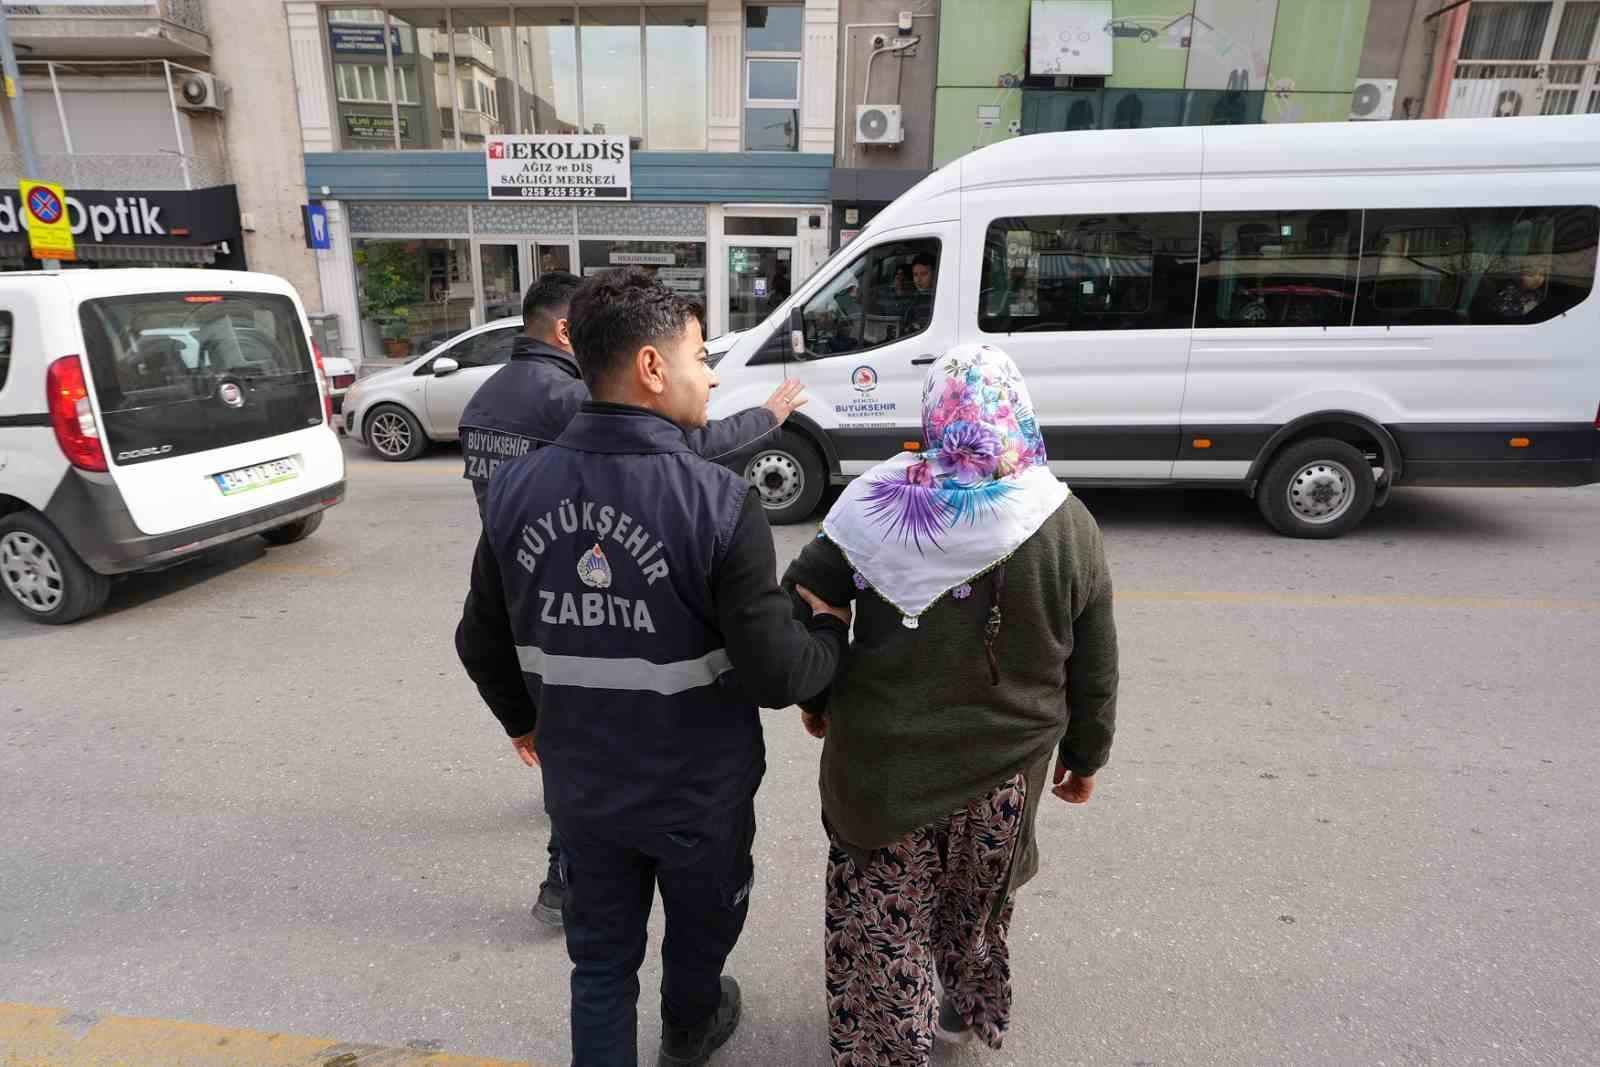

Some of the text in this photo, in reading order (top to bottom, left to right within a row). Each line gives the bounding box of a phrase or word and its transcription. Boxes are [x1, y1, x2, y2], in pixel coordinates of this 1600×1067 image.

[512, 139, 624, 163] EKOLDİŞ
[501, 174, 616, 185] SAĞLIĞI MERKEZİ
[522, 162, 552, 173] AĞIZ
[571, 162, 593, 174] DİŞ
[521, 188, 596, 197] 0258 265 55 22
[468, 430, 530, 457] BÜYÜKŞEHİR
[517, 499, 669, 585] BÜYÜKŞEHİR
[539, 590, 656, 633] ZABITA
